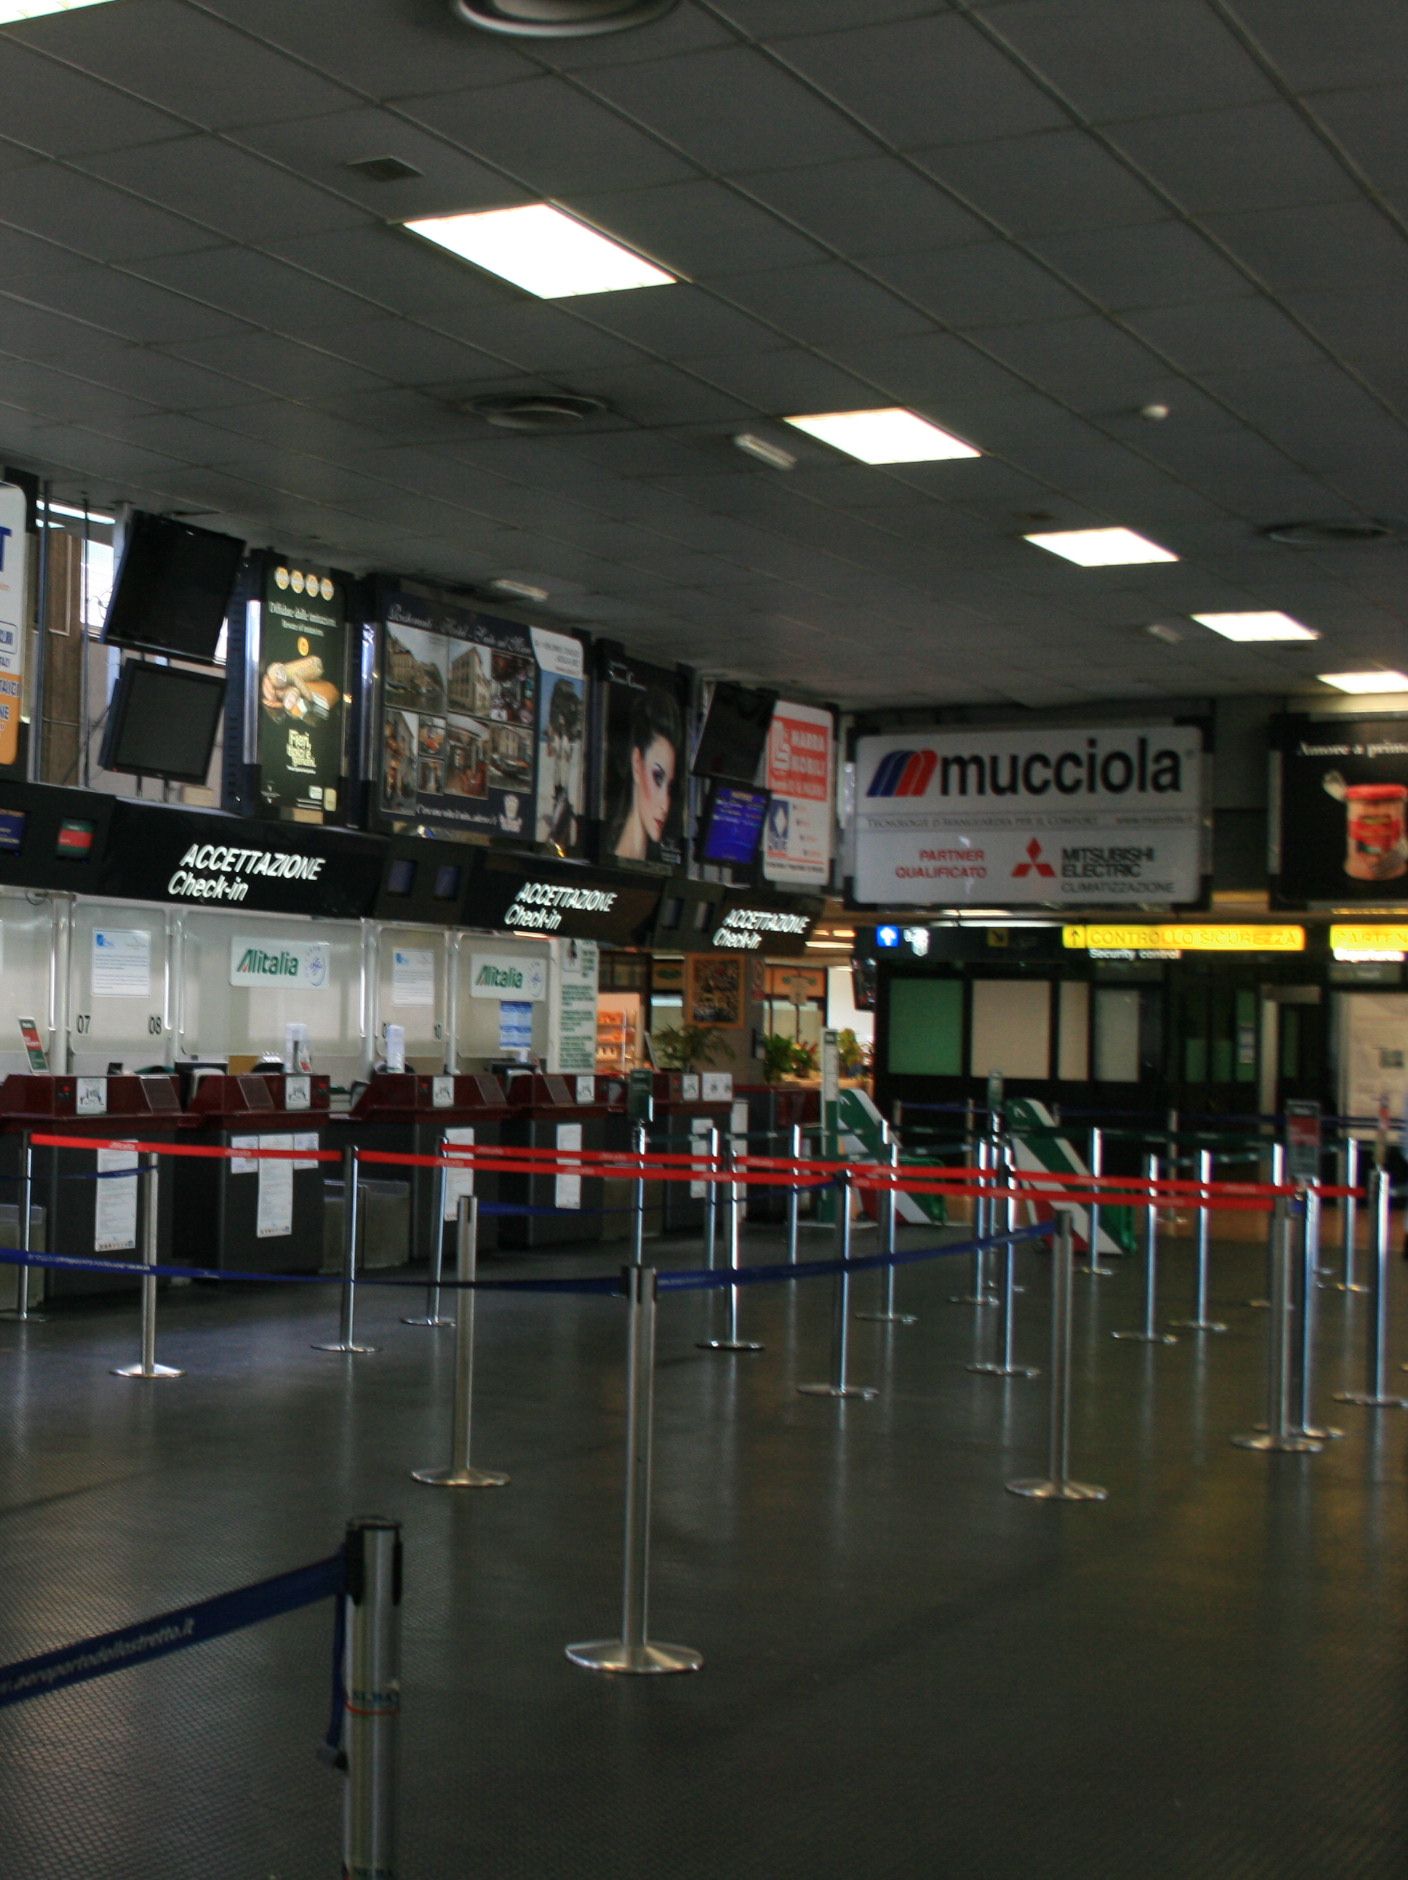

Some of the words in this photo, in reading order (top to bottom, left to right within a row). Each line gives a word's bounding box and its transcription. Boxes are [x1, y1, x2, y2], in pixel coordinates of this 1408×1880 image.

[940, 737, 1182, 797] mucciola
[179, 843, 327, 881] ACCETTAZIONE
[919, 849, 985, 862] PARTNER
[1061, 847, 1154, 863] MITSUBISHI
[895, 866, 988, 880] QUALIFICATO
[1061, 863, 1142, 879] ELECTRIC
[167, 870, 250, 902] Check-in
[1061, 880, 1176, 895] CLIMATIZZAZIONE
[515, 881, 618, 914] ACCETTAZIONE
[503, 903, 563, 930] Check-in
[722, 907, 811, 936] ACCETTAZIONE
[712, 926, 764, 950] Check-in
[1091, 930, 1195, 946] CONTROLLO
[1198, 930, 1299, 946] SICUREZZA
[237, 948, 299, 977] Alitalia
[1088, 948, 1136, 962] Security
[1138, 948, 1183, 961] control
[475, 964, 524, 989] Alitalia
[77, 1014, 91, 1035] 07
[148, 1015, 162, 1036] 08
